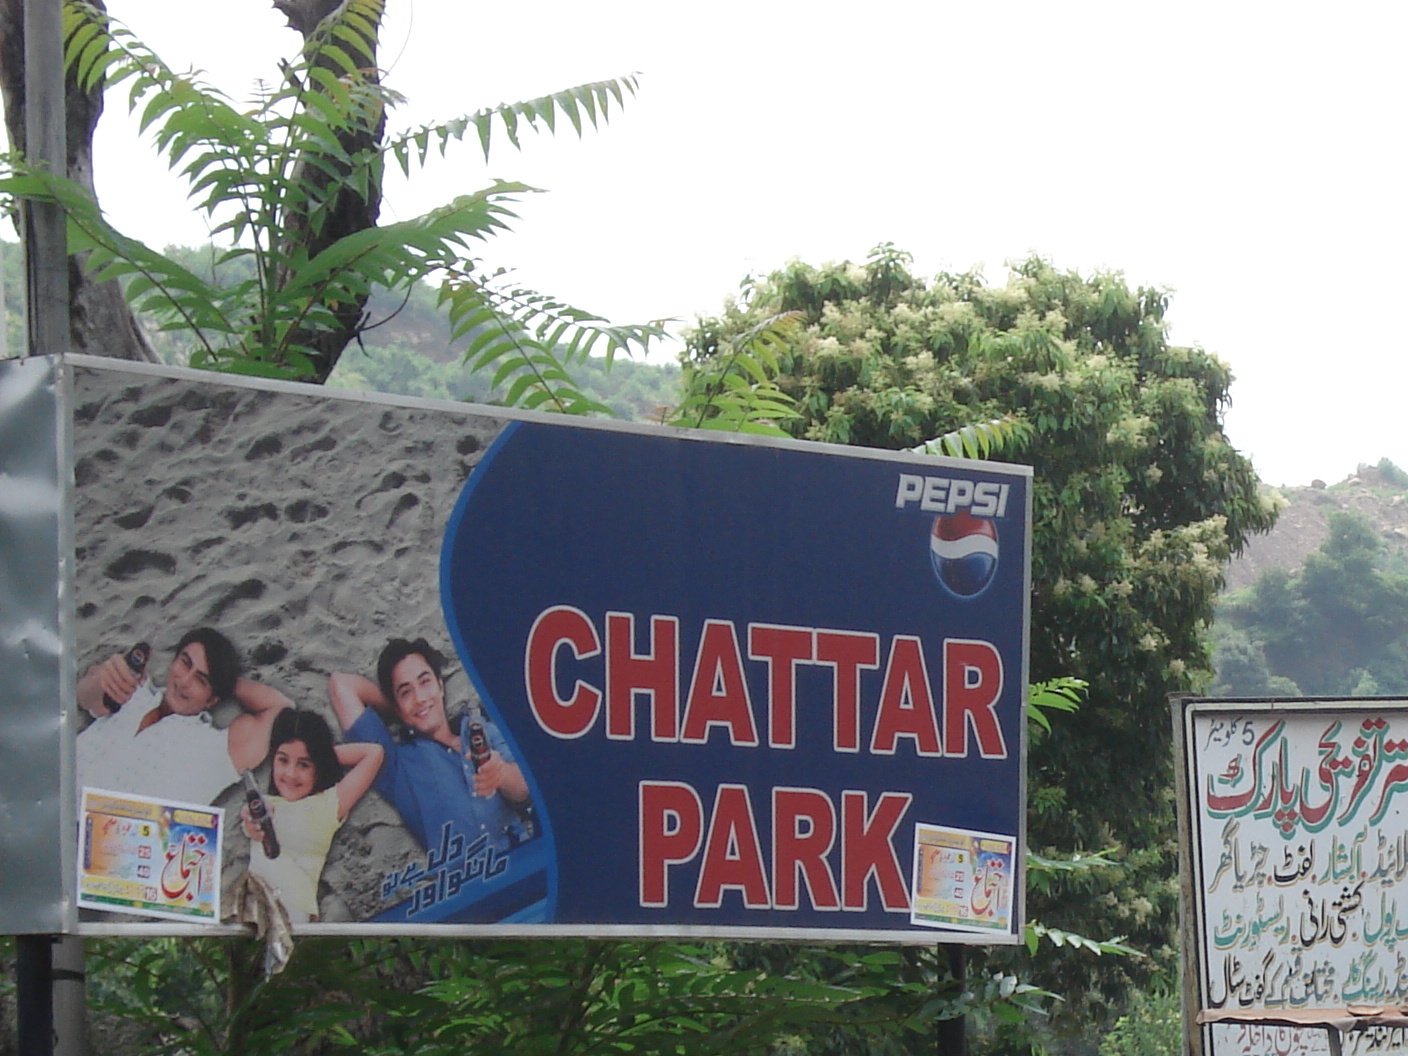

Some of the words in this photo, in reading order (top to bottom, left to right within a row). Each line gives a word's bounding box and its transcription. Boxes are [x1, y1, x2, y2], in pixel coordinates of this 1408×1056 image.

[895, 474, 1010, 517] PEPSI
[525, 605, 1007, 759] CHATTAR
[1241, 721, 1256, 746] 5
[1207, 718, 1302, 840] پارک
[639, 781, 913, 911] PARK
